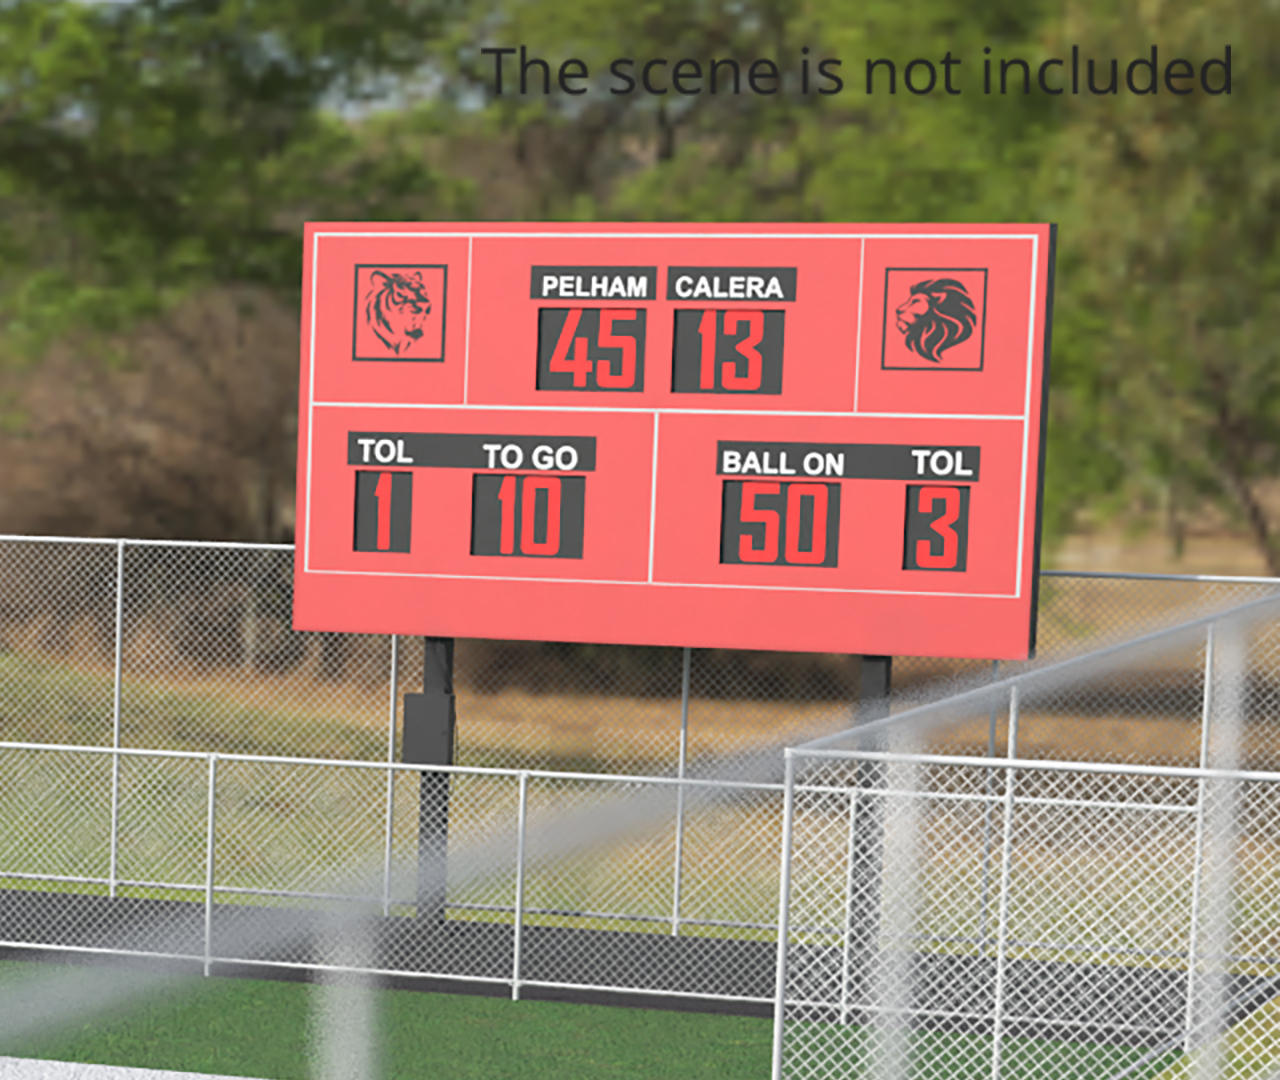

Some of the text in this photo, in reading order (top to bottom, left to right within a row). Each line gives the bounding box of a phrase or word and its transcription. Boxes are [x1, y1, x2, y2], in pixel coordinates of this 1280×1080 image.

[542, 275, 648, 297] PELHAM
[675, 276, 784, 298] CALERA
[549, 309, 637, 388] 45
[698, 310, 765, 390] 13
[357, 438, 413, 463] TOL
[483, 444, 578, 471] TO GO
[722, 450, 844, 476] BALL ON
[911, 449, 973, 476] TOL
[374, 472, 392, 551] 1
[498, 475, 562, 556] 10
[739, 482, 829, 564] 50
[916, 487, 960, 569] 3
